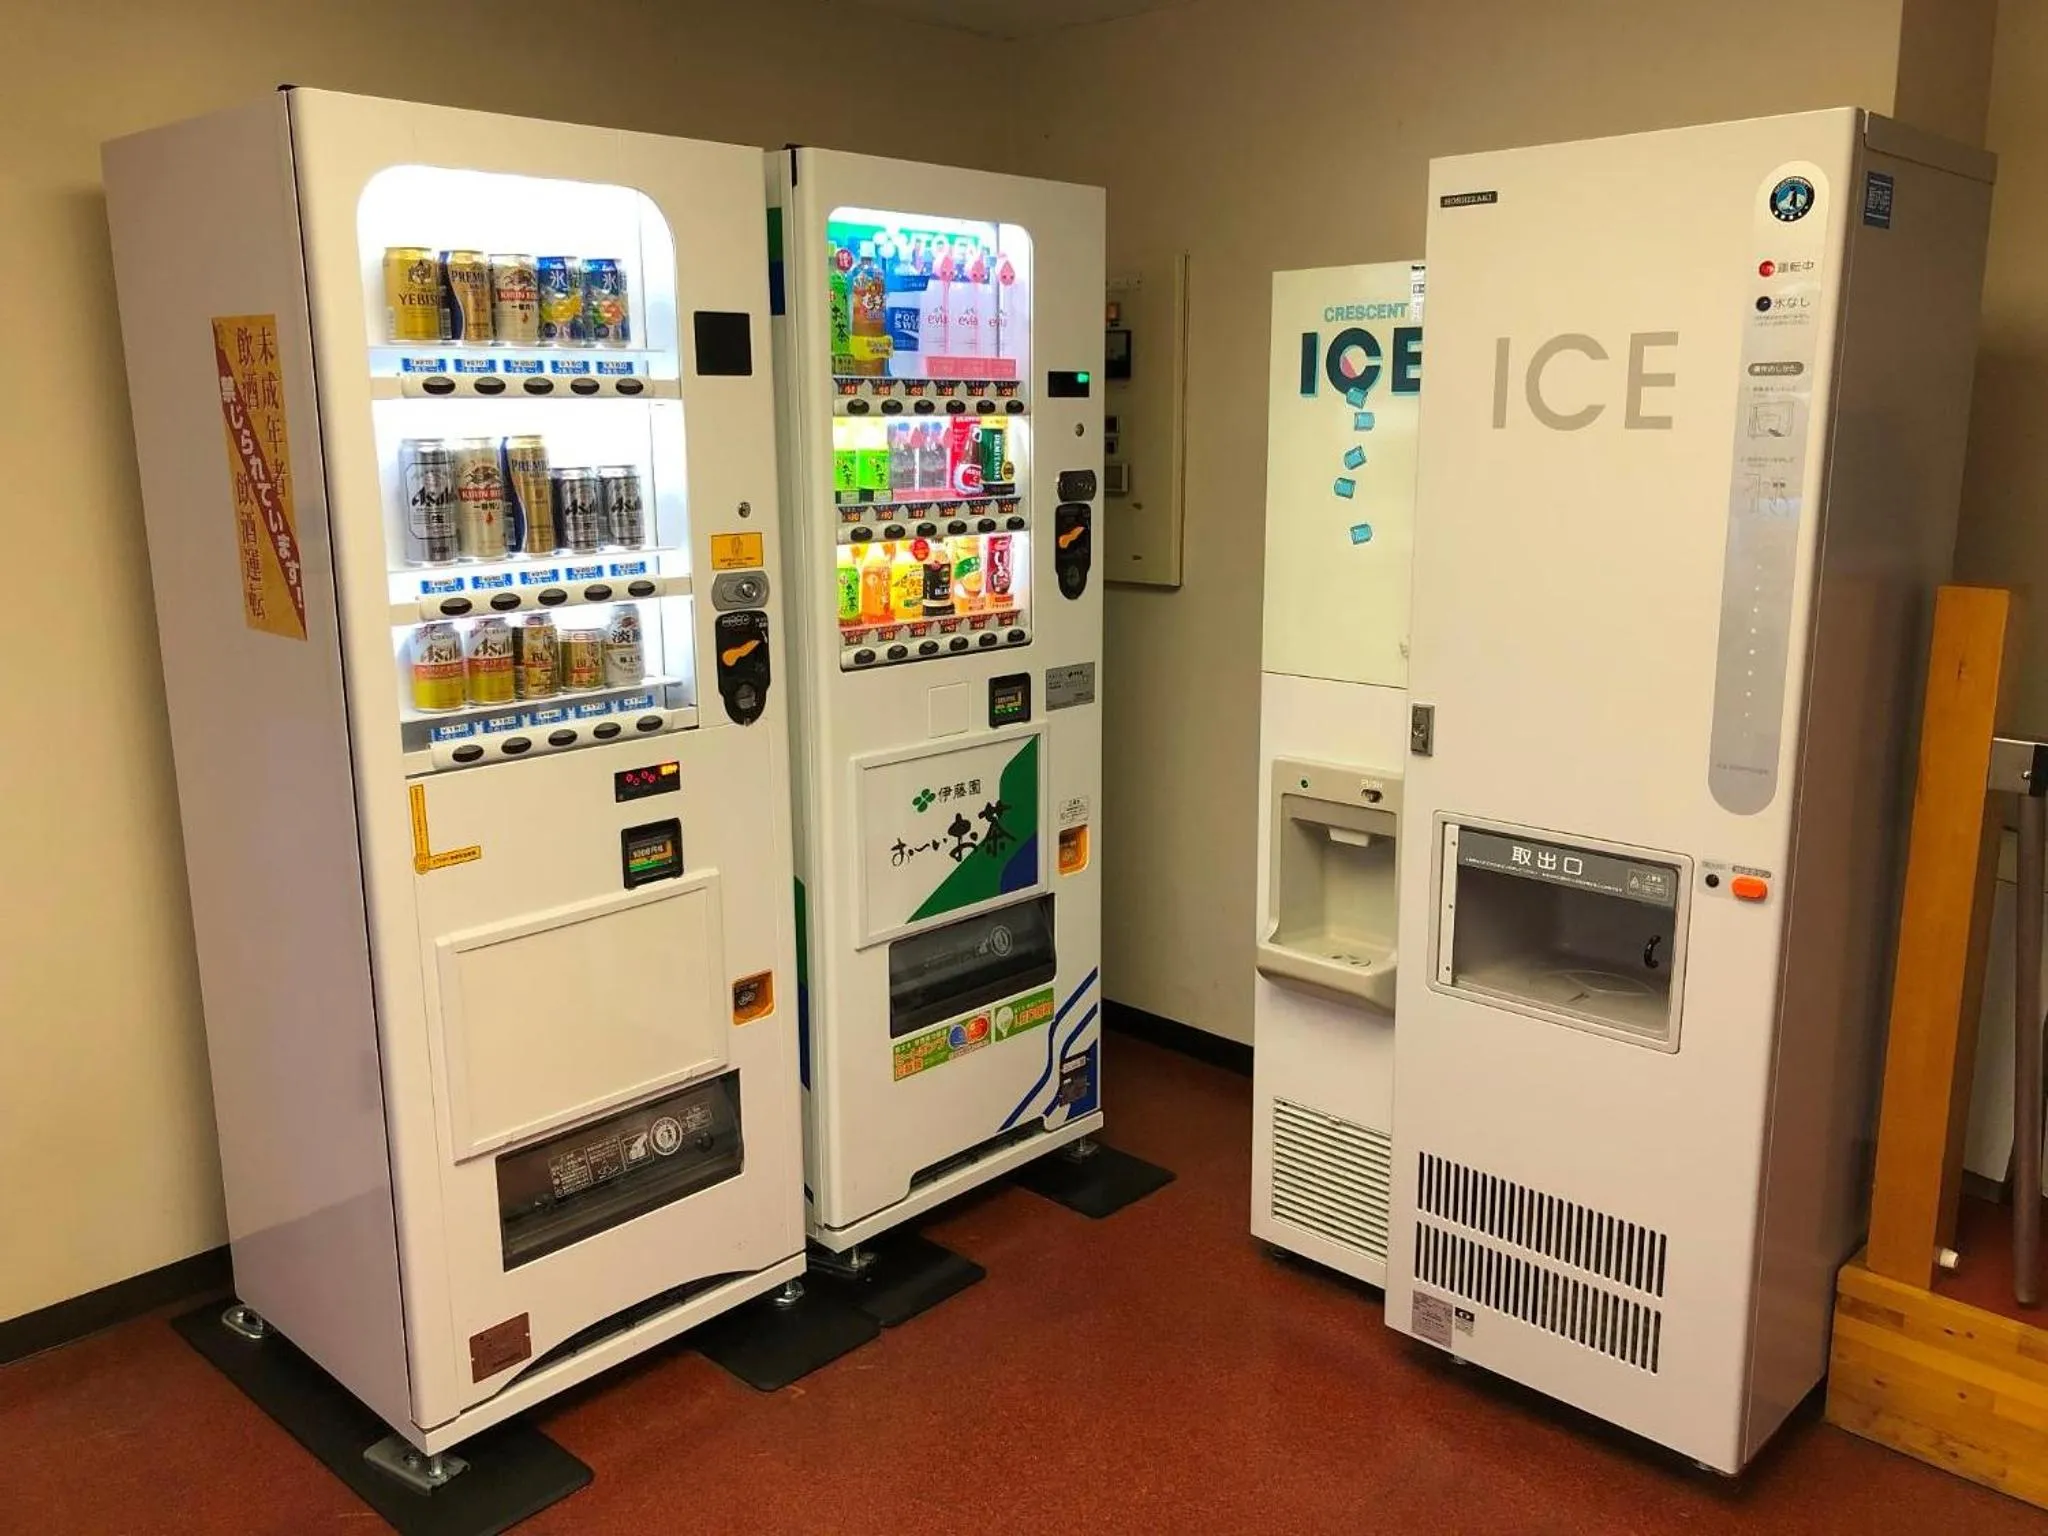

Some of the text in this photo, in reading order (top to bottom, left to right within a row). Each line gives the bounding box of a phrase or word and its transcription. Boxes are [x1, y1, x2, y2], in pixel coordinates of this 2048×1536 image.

[1443, 193, 1492, 206] HOSHIZAKI
[1324, 302, 1409, 323] CRESCENT
[1300, 326, 1422, 398] ICE
[1492, 331, 1679, 432] ICE
[257, 326, 287, 499] 未成年者
[938, 779, 981, 803] 伊藤園
[1511, 846, 1583, 876] 取出口
